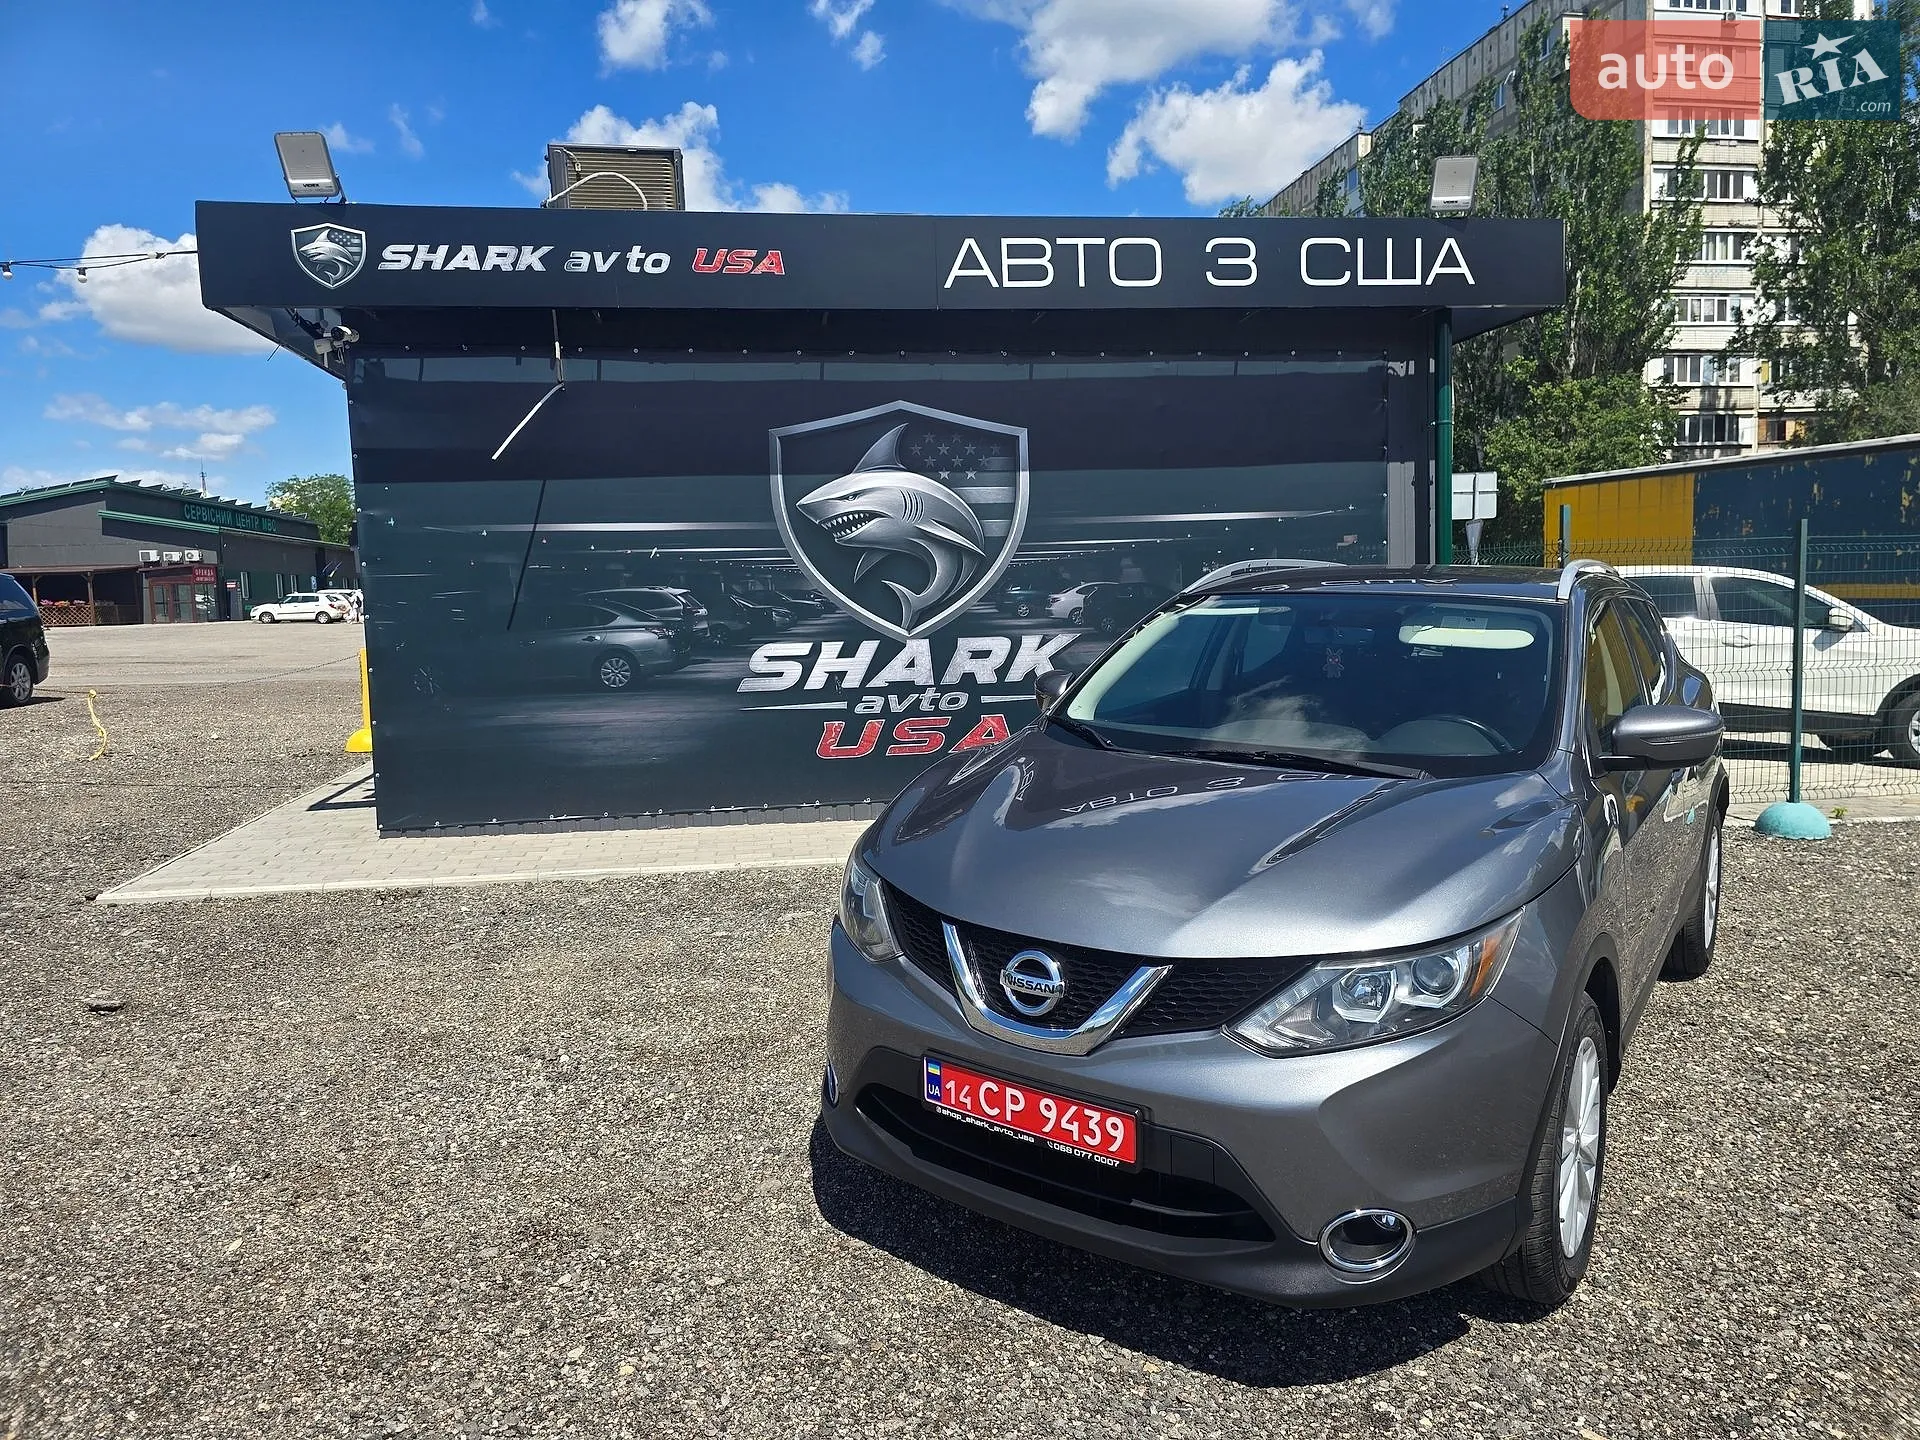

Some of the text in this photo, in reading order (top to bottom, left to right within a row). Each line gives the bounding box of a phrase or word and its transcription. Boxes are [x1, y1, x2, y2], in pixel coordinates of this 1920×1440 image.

[378, 244, 554, 272] SHARK
[691, 248, 786, 276] USA
[944, 237, 1163, 289] АВТО
[1300, 237, 1475, 287] США
[736, 633, 1082, 694] SHARK
[854, 686, 969, 715] avto
[816, 714, 1011, 760] USA
[1004, 972, 1055, 994] NISSAN
[928, 1083, 941, 1097] UA
[1038, 1097, 1126, 1153] 9439
